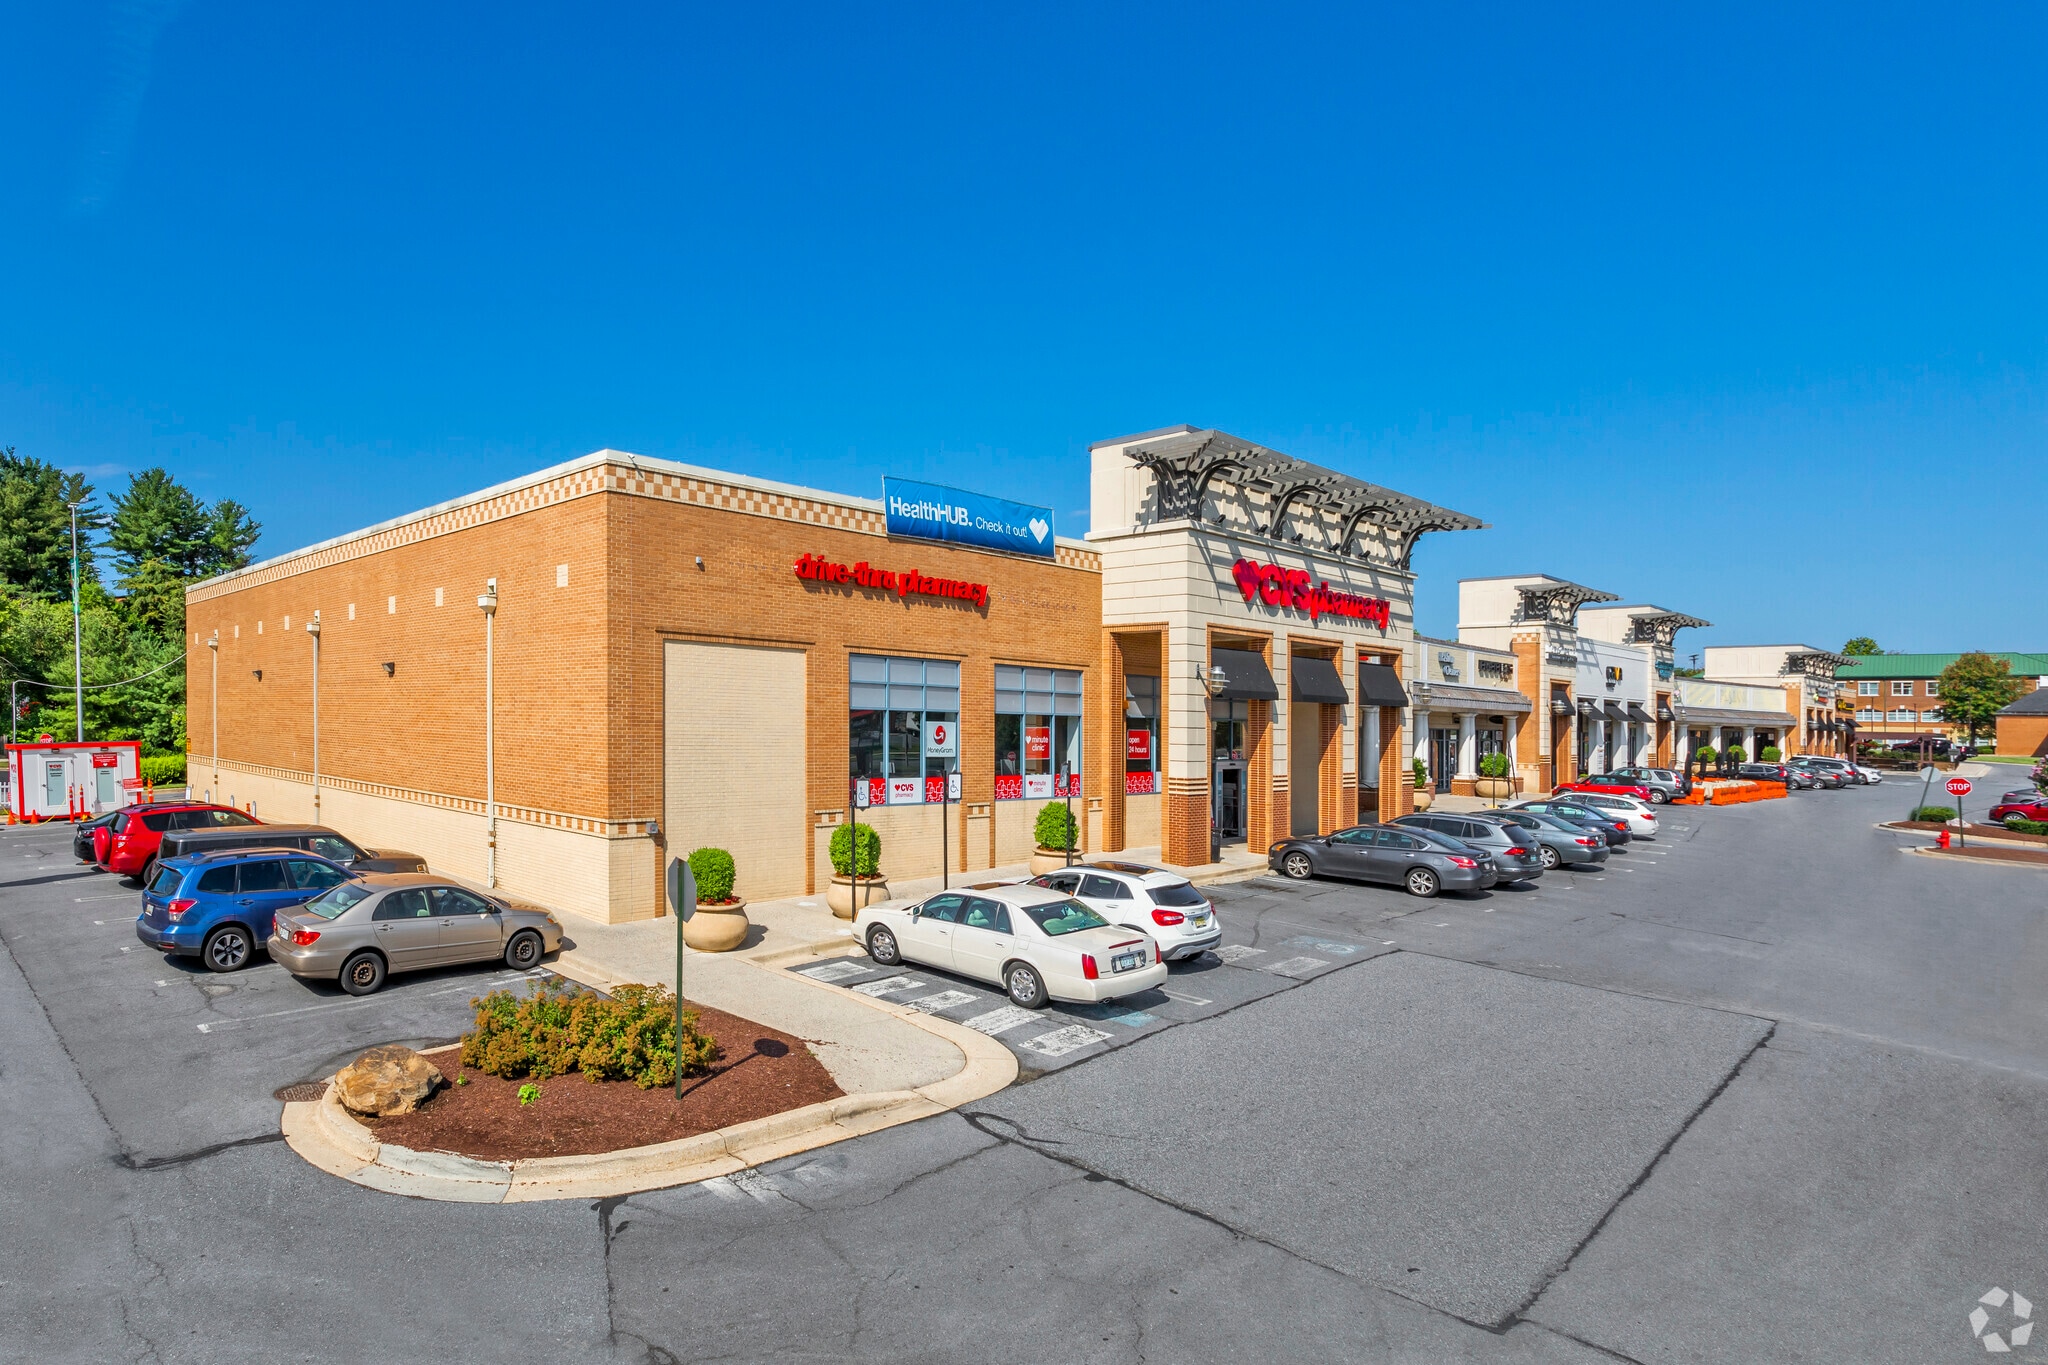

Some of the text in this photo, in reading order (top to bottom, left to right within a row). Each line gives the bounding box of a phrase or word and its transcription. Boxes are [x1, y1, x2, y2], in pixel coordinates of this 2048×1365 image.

[975, 517, 1003, 533] Check
[1005, 522, 1011, 535] it
[1012, 527, 1028, 538] out!
[793, 553, 989, 606] drive-thru pharmacy
[1258, 563, 1390, 629] CVS pharmacy
[1128, 737, 1140, 745] open
[1947, 783, 1970, 791] STOP
